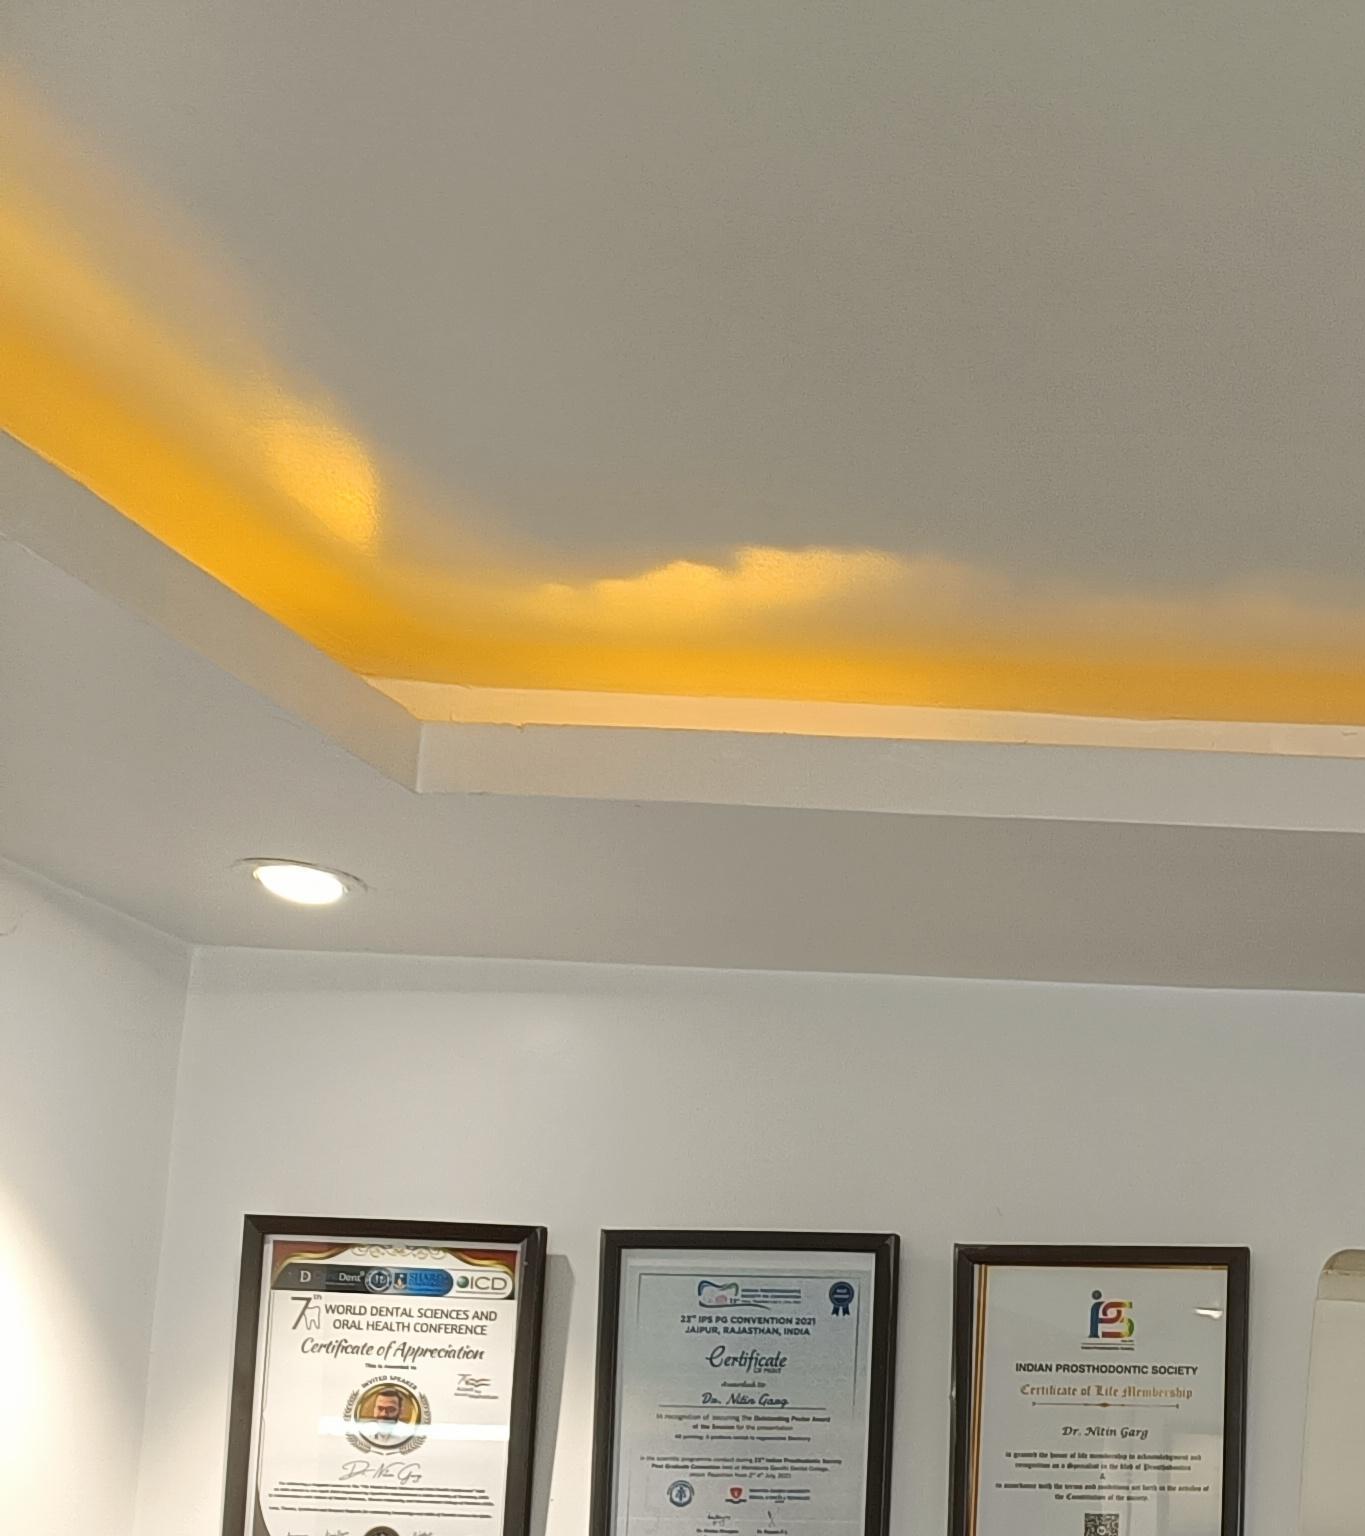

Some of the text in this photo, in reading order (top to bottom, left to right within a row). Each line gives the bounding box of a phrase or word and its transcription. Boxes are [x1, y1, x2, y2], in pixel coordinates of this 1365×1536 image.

[325, 1304, 497, 1321] WORLD DENTAL SCIENCES AND
[333, 1319, 487, 1335] ORAL HEALTH CONFERENCE
[699, 1315, 816, 1326] IPS PG CONVENTION 2021
[685, 1326, 810, 1336] JAIPUR, RAJASTHAN, INDIA
[301, 1337, 484, 1363] Certificate of Appreciation
[705, 1345, 787, 1373] Certificate
[1016, 1363, 1198, 1375] INDIAN PROSTHODONTIC SOCIETY
[361, 1376, 418, 1390] INVITED SPEAKER
[1020, 1384, 1193, 1399] Certificate of Life Membership
[1062, 1427, 1148, 1440] Dr. Nitin Garg
